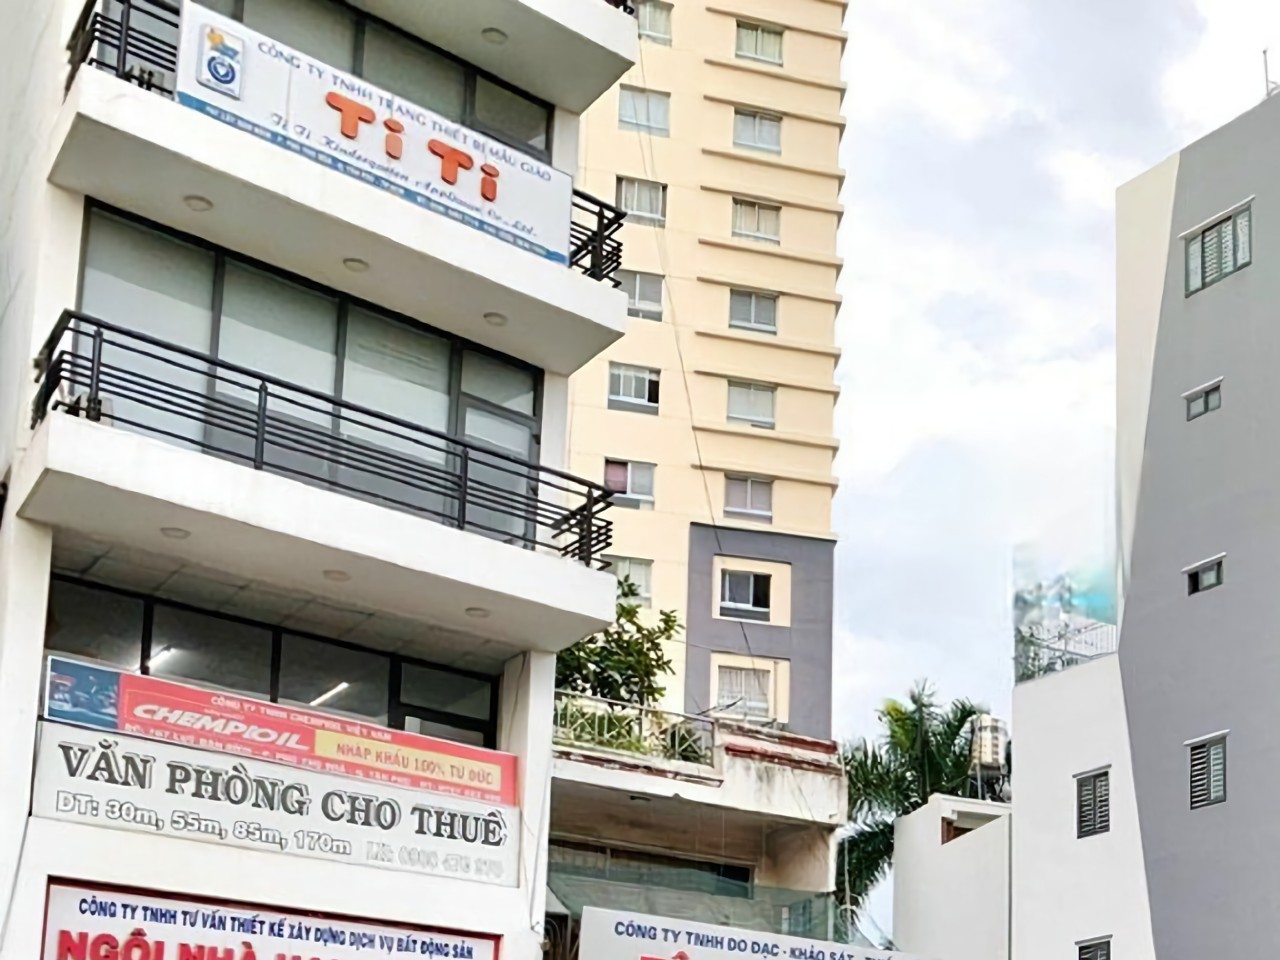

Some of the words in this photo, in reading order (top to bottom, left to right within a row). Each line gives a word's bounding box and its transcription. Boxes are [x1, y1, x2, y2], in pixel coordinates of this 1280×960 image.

[258, 42, 300, 69] CÔNG
[307, 62, 324, 79] TY
[332, 73, 373, 100] TNHH
[326, 91, 404, 160] Ti
[427, 138, 500, 203] Ti
[57, 739, 157, 790] VĂN
[164, 759, 312, 817] PHÒNG
[320, 789, 402, 831] CHO
[105, 798, 165, 832] 30m,
[170, 810, 228, 841] 55m,
[232, 820, 289, 851] 85m,
[293, 830, 352, 856] 170m
[78, 895, 118, 919] CÔNG
[121, 903, 140, 919] TY
[141, 906, 178, 926] TNHH
[181, 909, 200, 928] TƯ
[201, 909, 227, 932] VẤN
[230, 913, 266, 936] THIẾT
[267, 916, 287, 938] KẾ
[288, 921, 312, 942] XÂY
[614, 920, 658, 941] CÔNG
[661, 928, 682, 944] TY
[685, 931, 725, 950] TNHH
